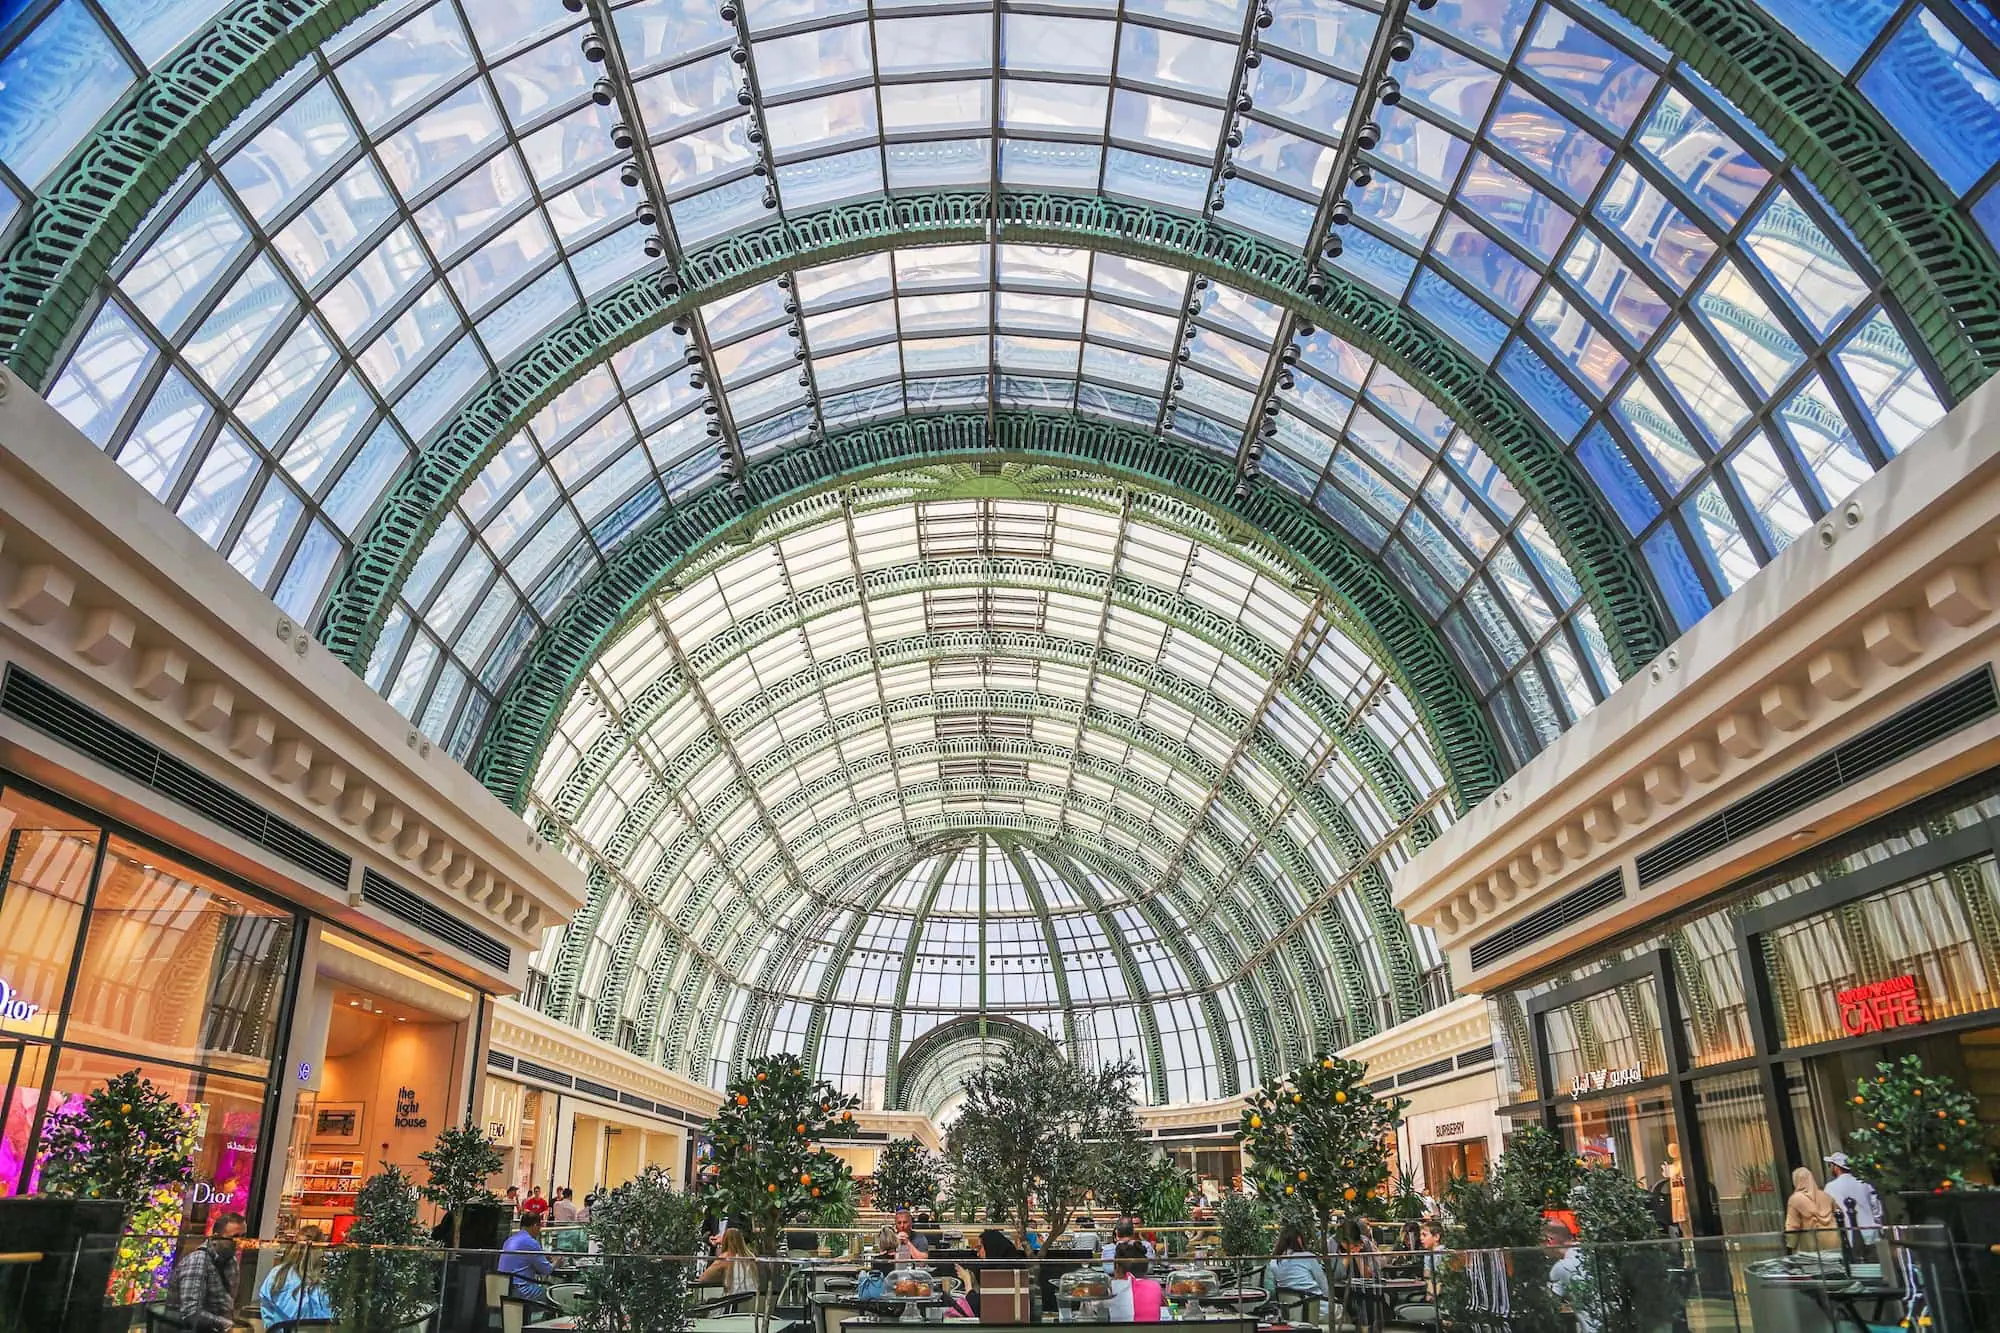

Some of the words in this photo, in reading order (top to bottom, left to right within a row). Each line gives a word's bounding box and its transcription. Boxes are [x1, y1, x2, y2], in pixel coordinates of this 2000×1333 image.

[399, 1086, 415, 1099] the
[396, 1100, 419, 1116] light
[395, 1113, 427, 1128] house
[193, 1182, 234, 1204] Dior
